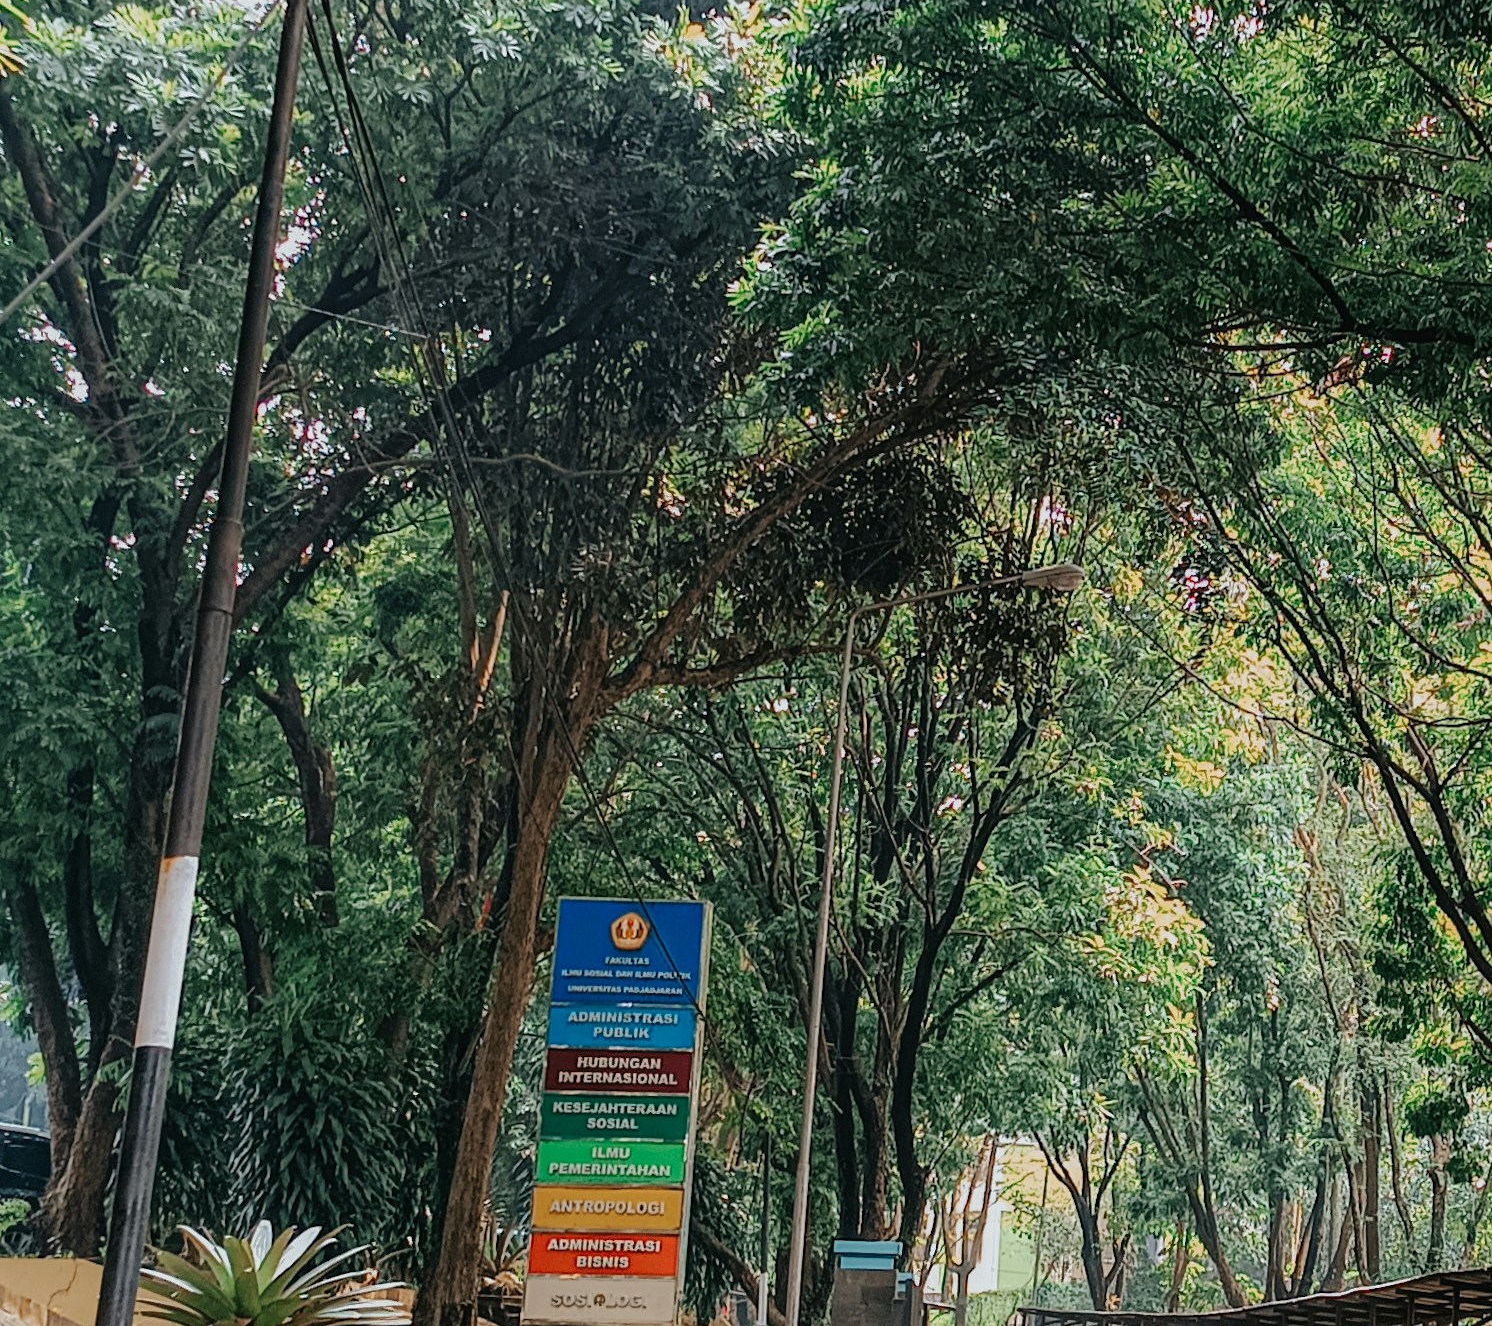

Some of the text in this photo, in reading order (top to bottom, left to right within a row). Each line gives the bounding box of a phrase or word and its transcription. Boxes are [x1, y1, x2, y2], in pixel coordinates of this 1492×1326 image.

[605, 956, 650, 965] FAKULTAS
[583, 970, 614, 978] SOSIAL
[615, 970, 634, 978] DAN
[567, 985, 683, 995] UNIVERSITAS PADJADJARAN
[567, 1011, 679, 1025] ADMINISTRASI
[593, 1026, 650, 1039] PUBLIK
[576, 1056, 662, 1070] HUBUNGAN
[558, 1071, 678, 1086] INTERNASIONAL
[552, 1101, 677, 1115] KESEJAHTERAAN
[586, 1117, 639, 1130] SOSIAL
[591, 1146, 631, 1159] ILMU
[548, 1162, 671, 1177] PEMERINTAHAN
[549, 1199, 665, 1215] ANTROPOLOGI
[547, 1238, 661, 1253] ADMINISTRASI
[576, 1255, 629, 1269] BISNIS
